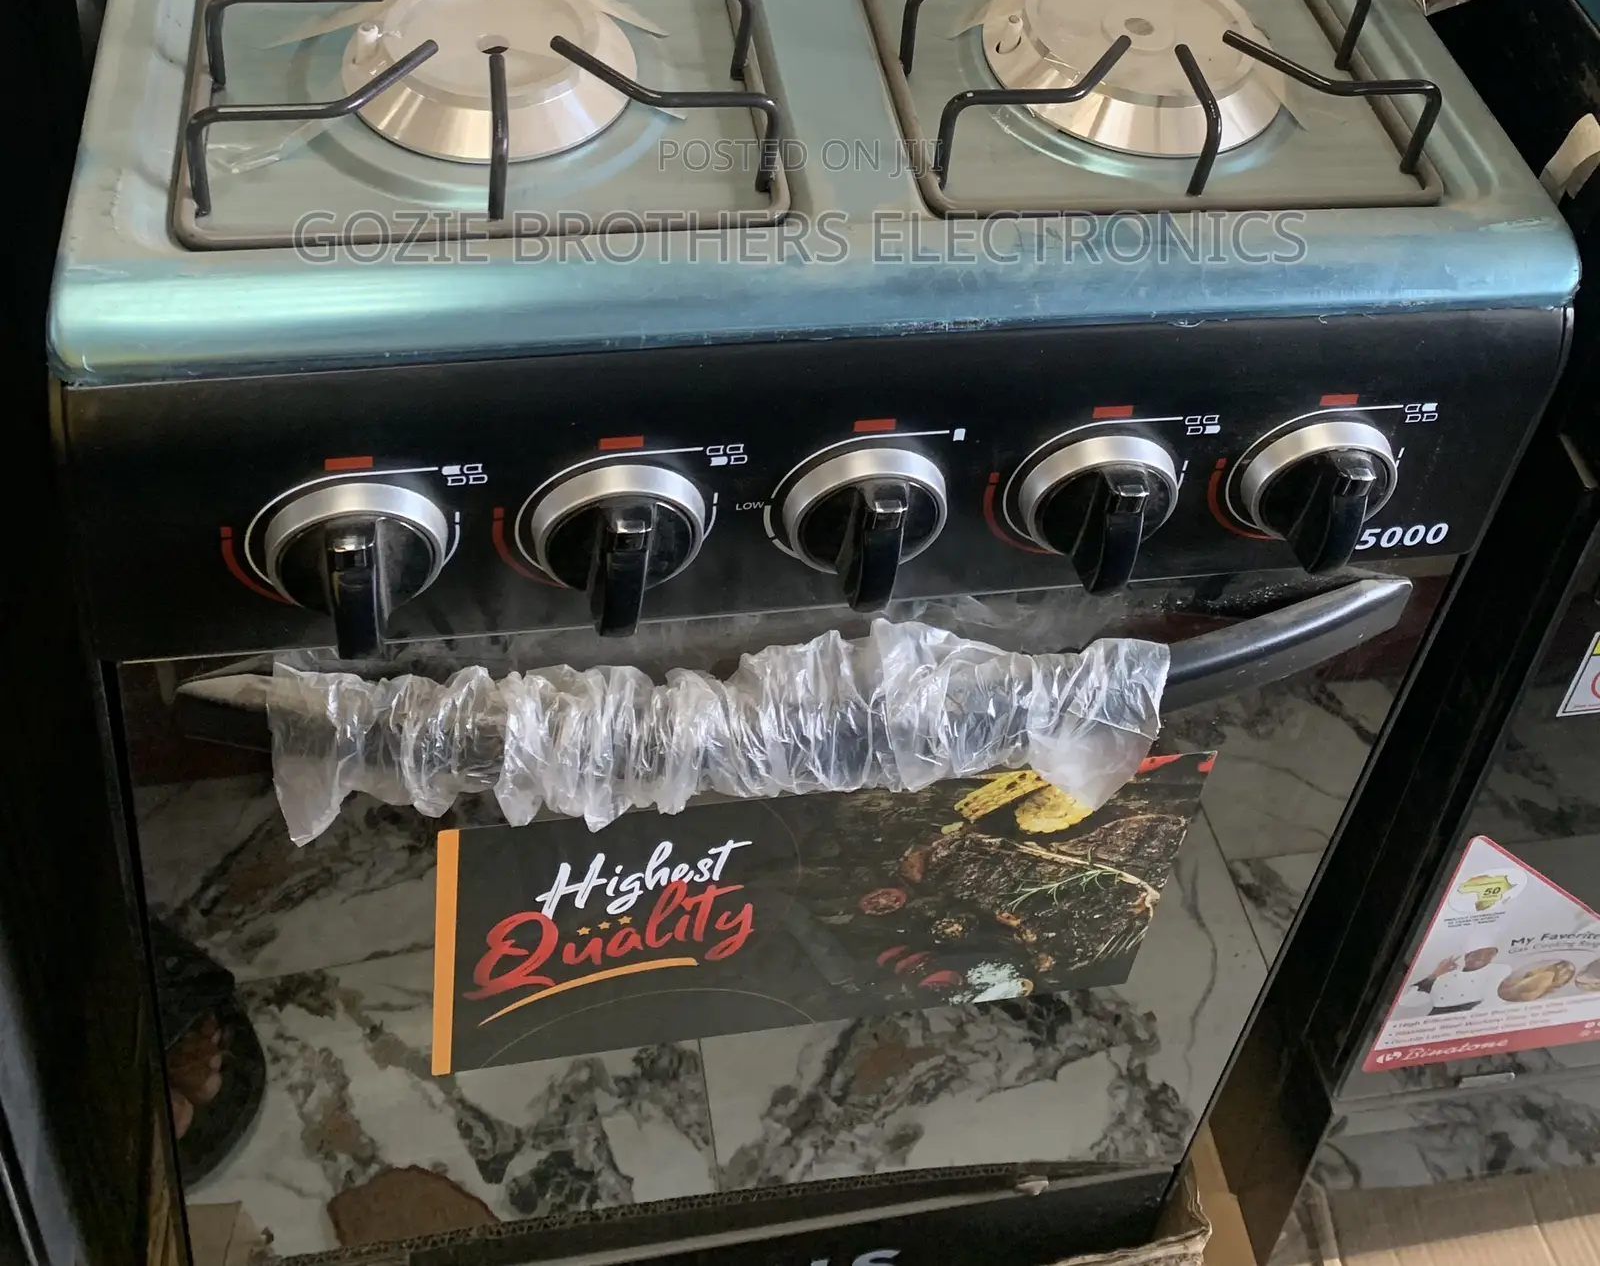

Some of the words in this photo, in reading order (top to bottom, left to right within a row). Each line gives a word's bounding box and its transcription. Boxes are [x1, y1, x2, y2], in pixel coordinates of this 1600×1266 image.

[735, 501, 765, 511] LOW
[1355, 522, 1449, 550] 5000
[535, 839, 752, 920] Highest
[1483, 887, 1502, 896] 50
[462, 880, 754, 1001] Quality
[1511, 937, 1535, 946] My
[1401, 1039, 1508, 1061] Binatone
